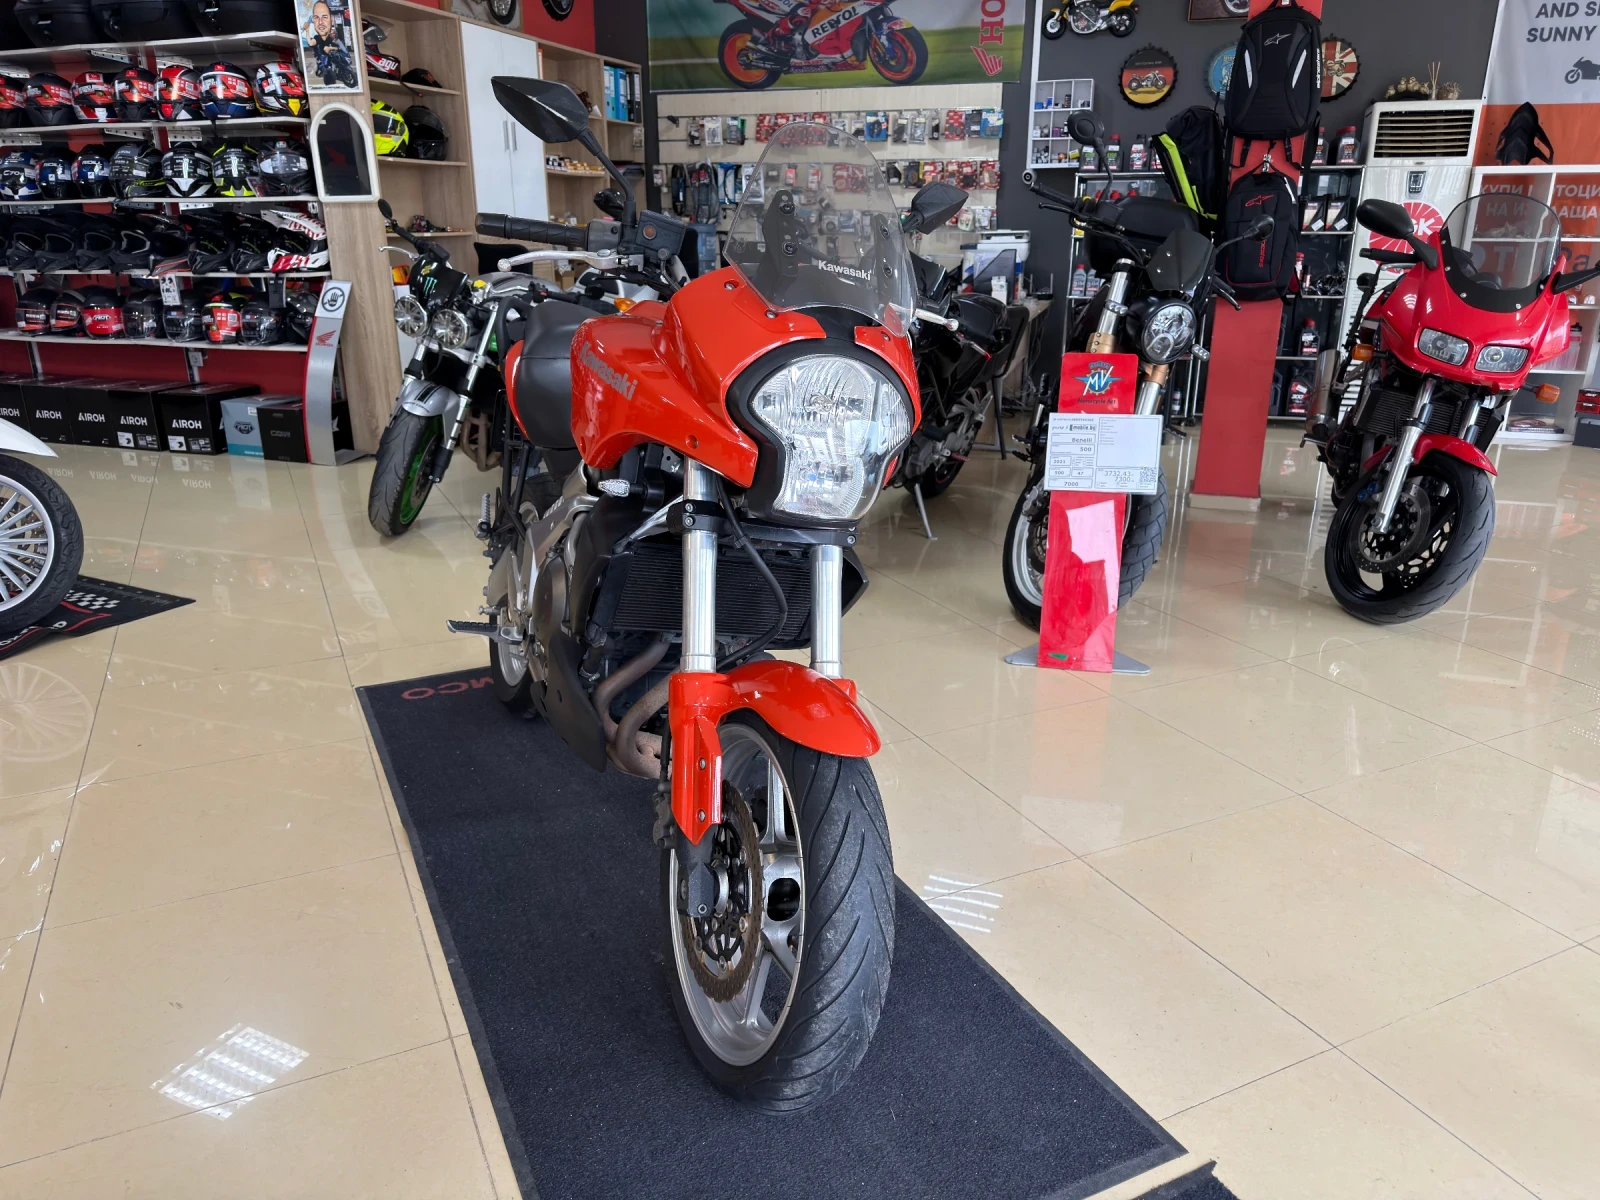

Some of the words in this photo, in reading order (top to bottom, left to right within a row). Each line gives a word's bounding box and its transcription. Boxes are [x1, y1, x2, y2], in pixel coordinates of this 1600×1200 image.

[1535, 2, 1580, 18] AND
[1526, 25, 1598, 43] SUNNY
[379, 57, 399, 71] agv
[818, 260, 872, 281] Kawasaki
[579, 341, 638, 401] Kawasaki
[36, 410, 62, 420] AIROH
[78, 412, 105, 423] AIROH
[120, 415, 148, 426] AIROH
[172, 418, 202, 430] AIROH
